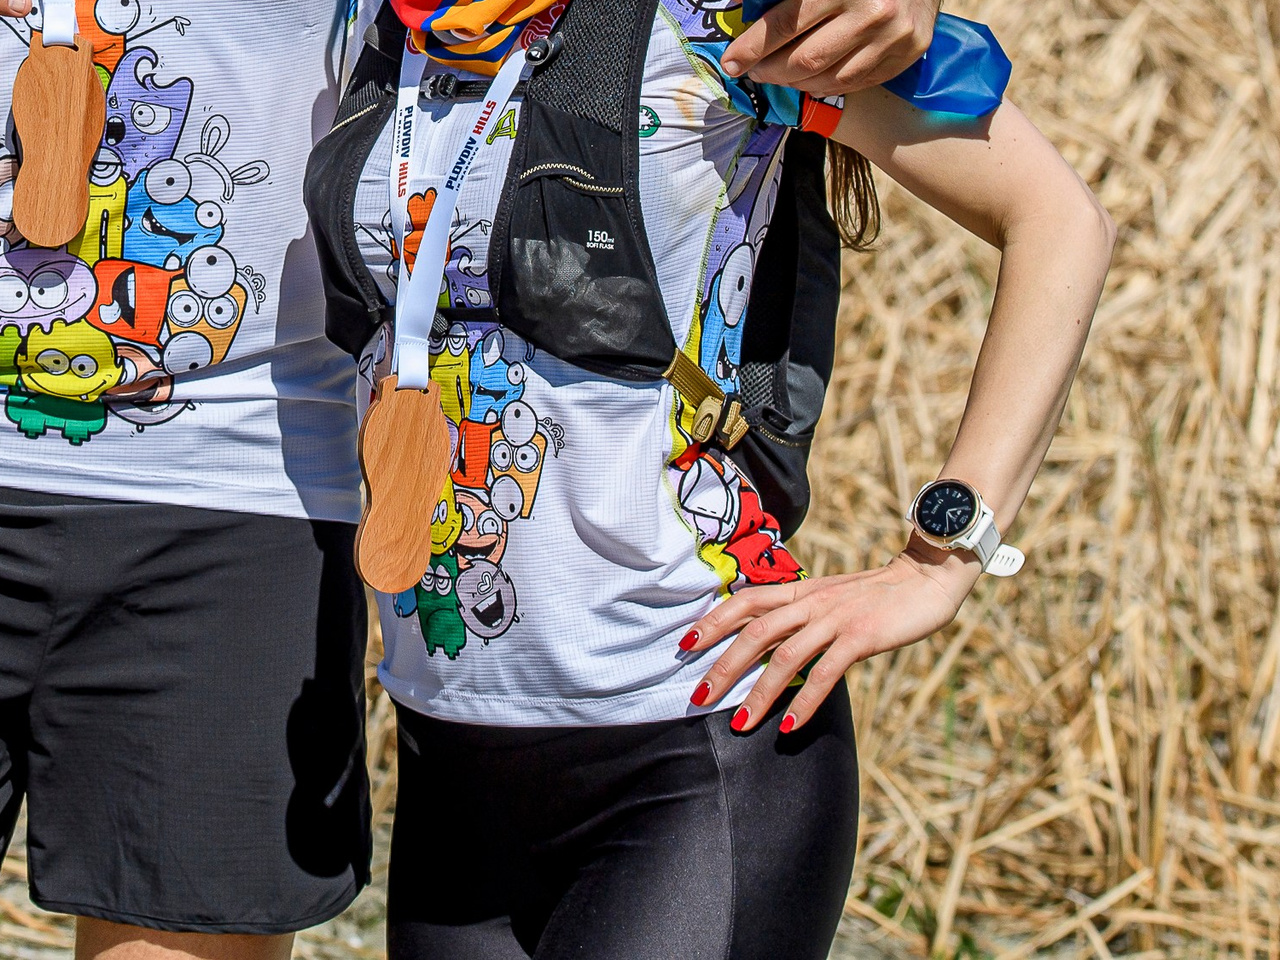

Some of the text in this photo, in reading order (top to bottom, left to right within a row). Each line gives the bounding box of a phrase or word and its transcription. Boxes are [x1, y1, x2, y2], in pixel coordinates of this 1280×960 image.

[397, 105, 414, 198] PLOVDIV HILLS
[445, 100, 497, 191] PLOVDIV HILLS
